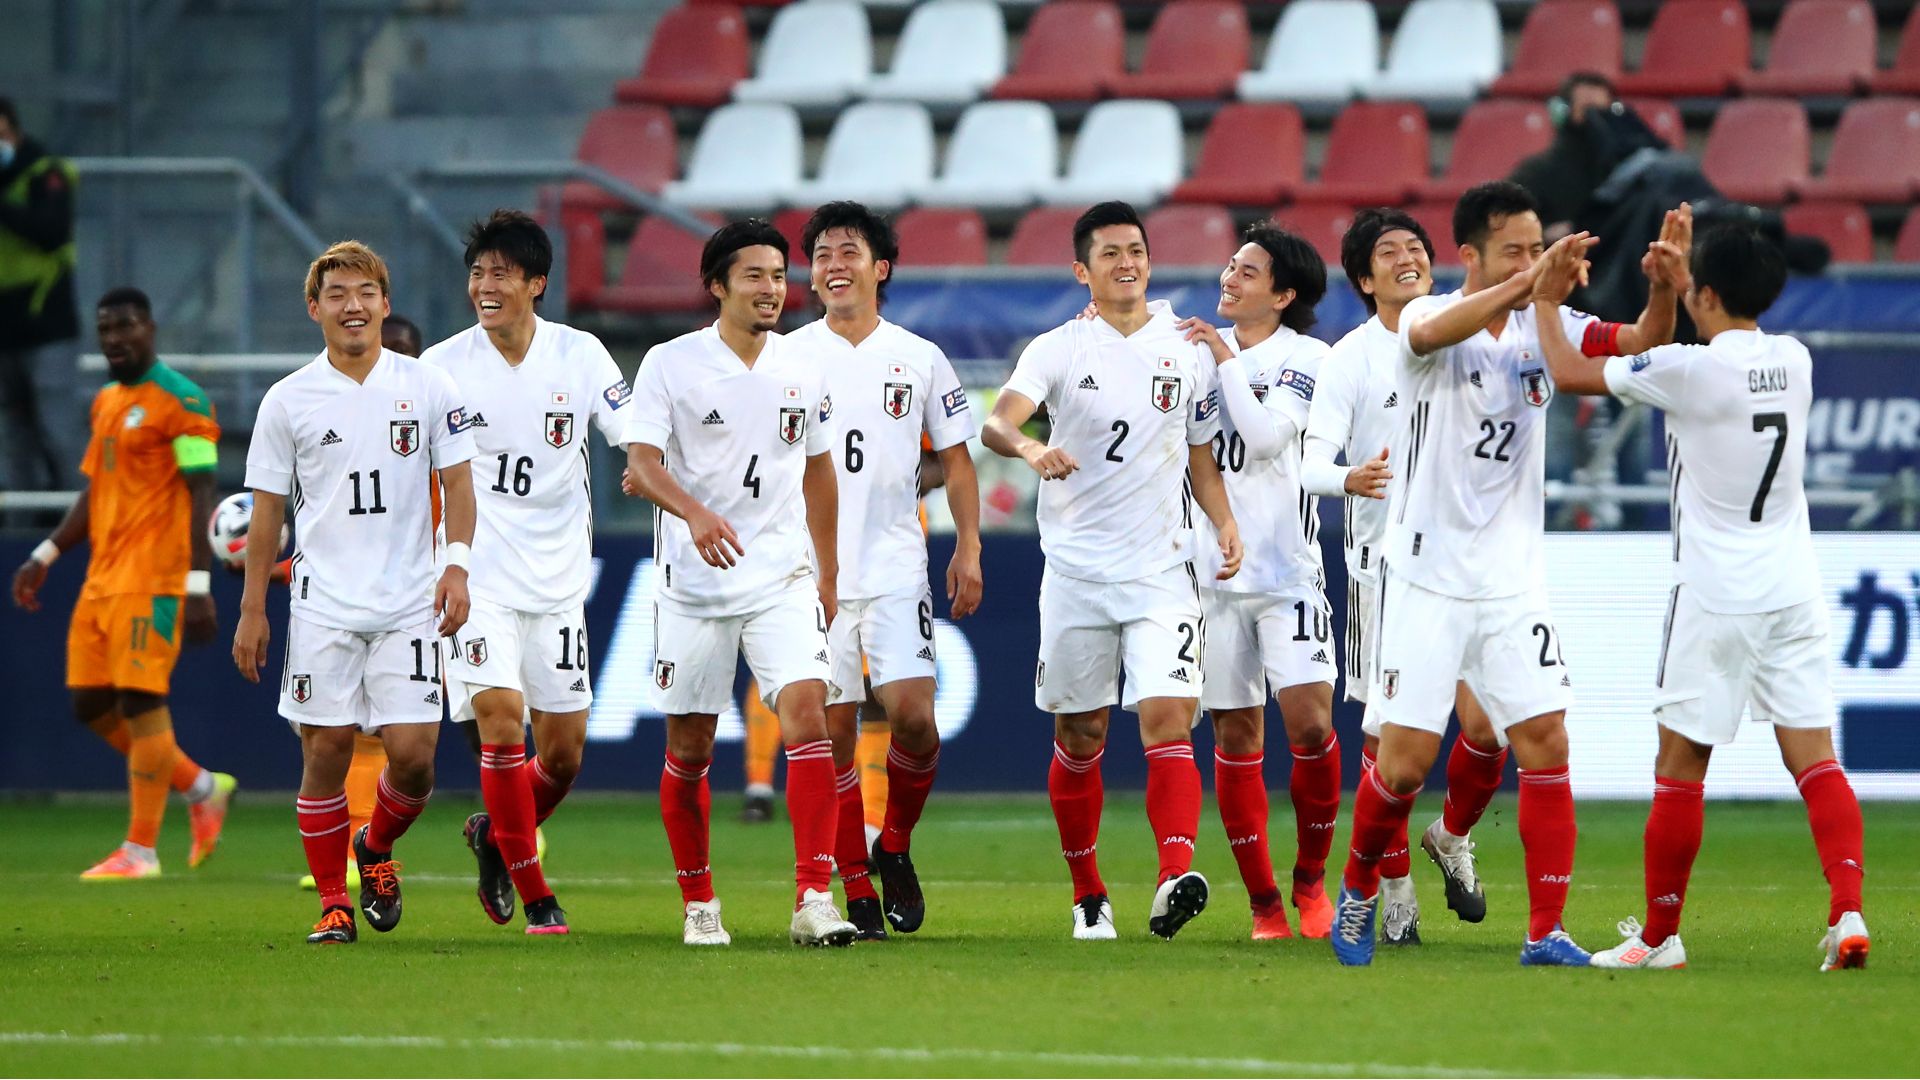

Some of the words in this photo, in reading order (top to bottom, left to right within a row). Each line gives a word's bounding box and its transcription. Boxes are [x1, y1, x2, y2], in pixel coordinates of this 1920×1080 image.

[1749, 367, 1787, 393] GAKU
[845, 428, 864, 473] 6
[1105, 419, 1130, 463] 2
[1474, 418, 1516, 462] 22
[491, 453, 534, 496] 16
[742, 454, 760, 499] 4
[1750, 412, 1788, 522] 7
[348, 469, 387, 515] 11
[918, 599, 932, 641] 6
[1293, 600, 1328, 643] 10
[410, 638, 441, 685] 11
[556, 626, 586, 671] 16
[1177, 622, 1194, 663] 2
[1231, 833, 1258, 846] PAN
